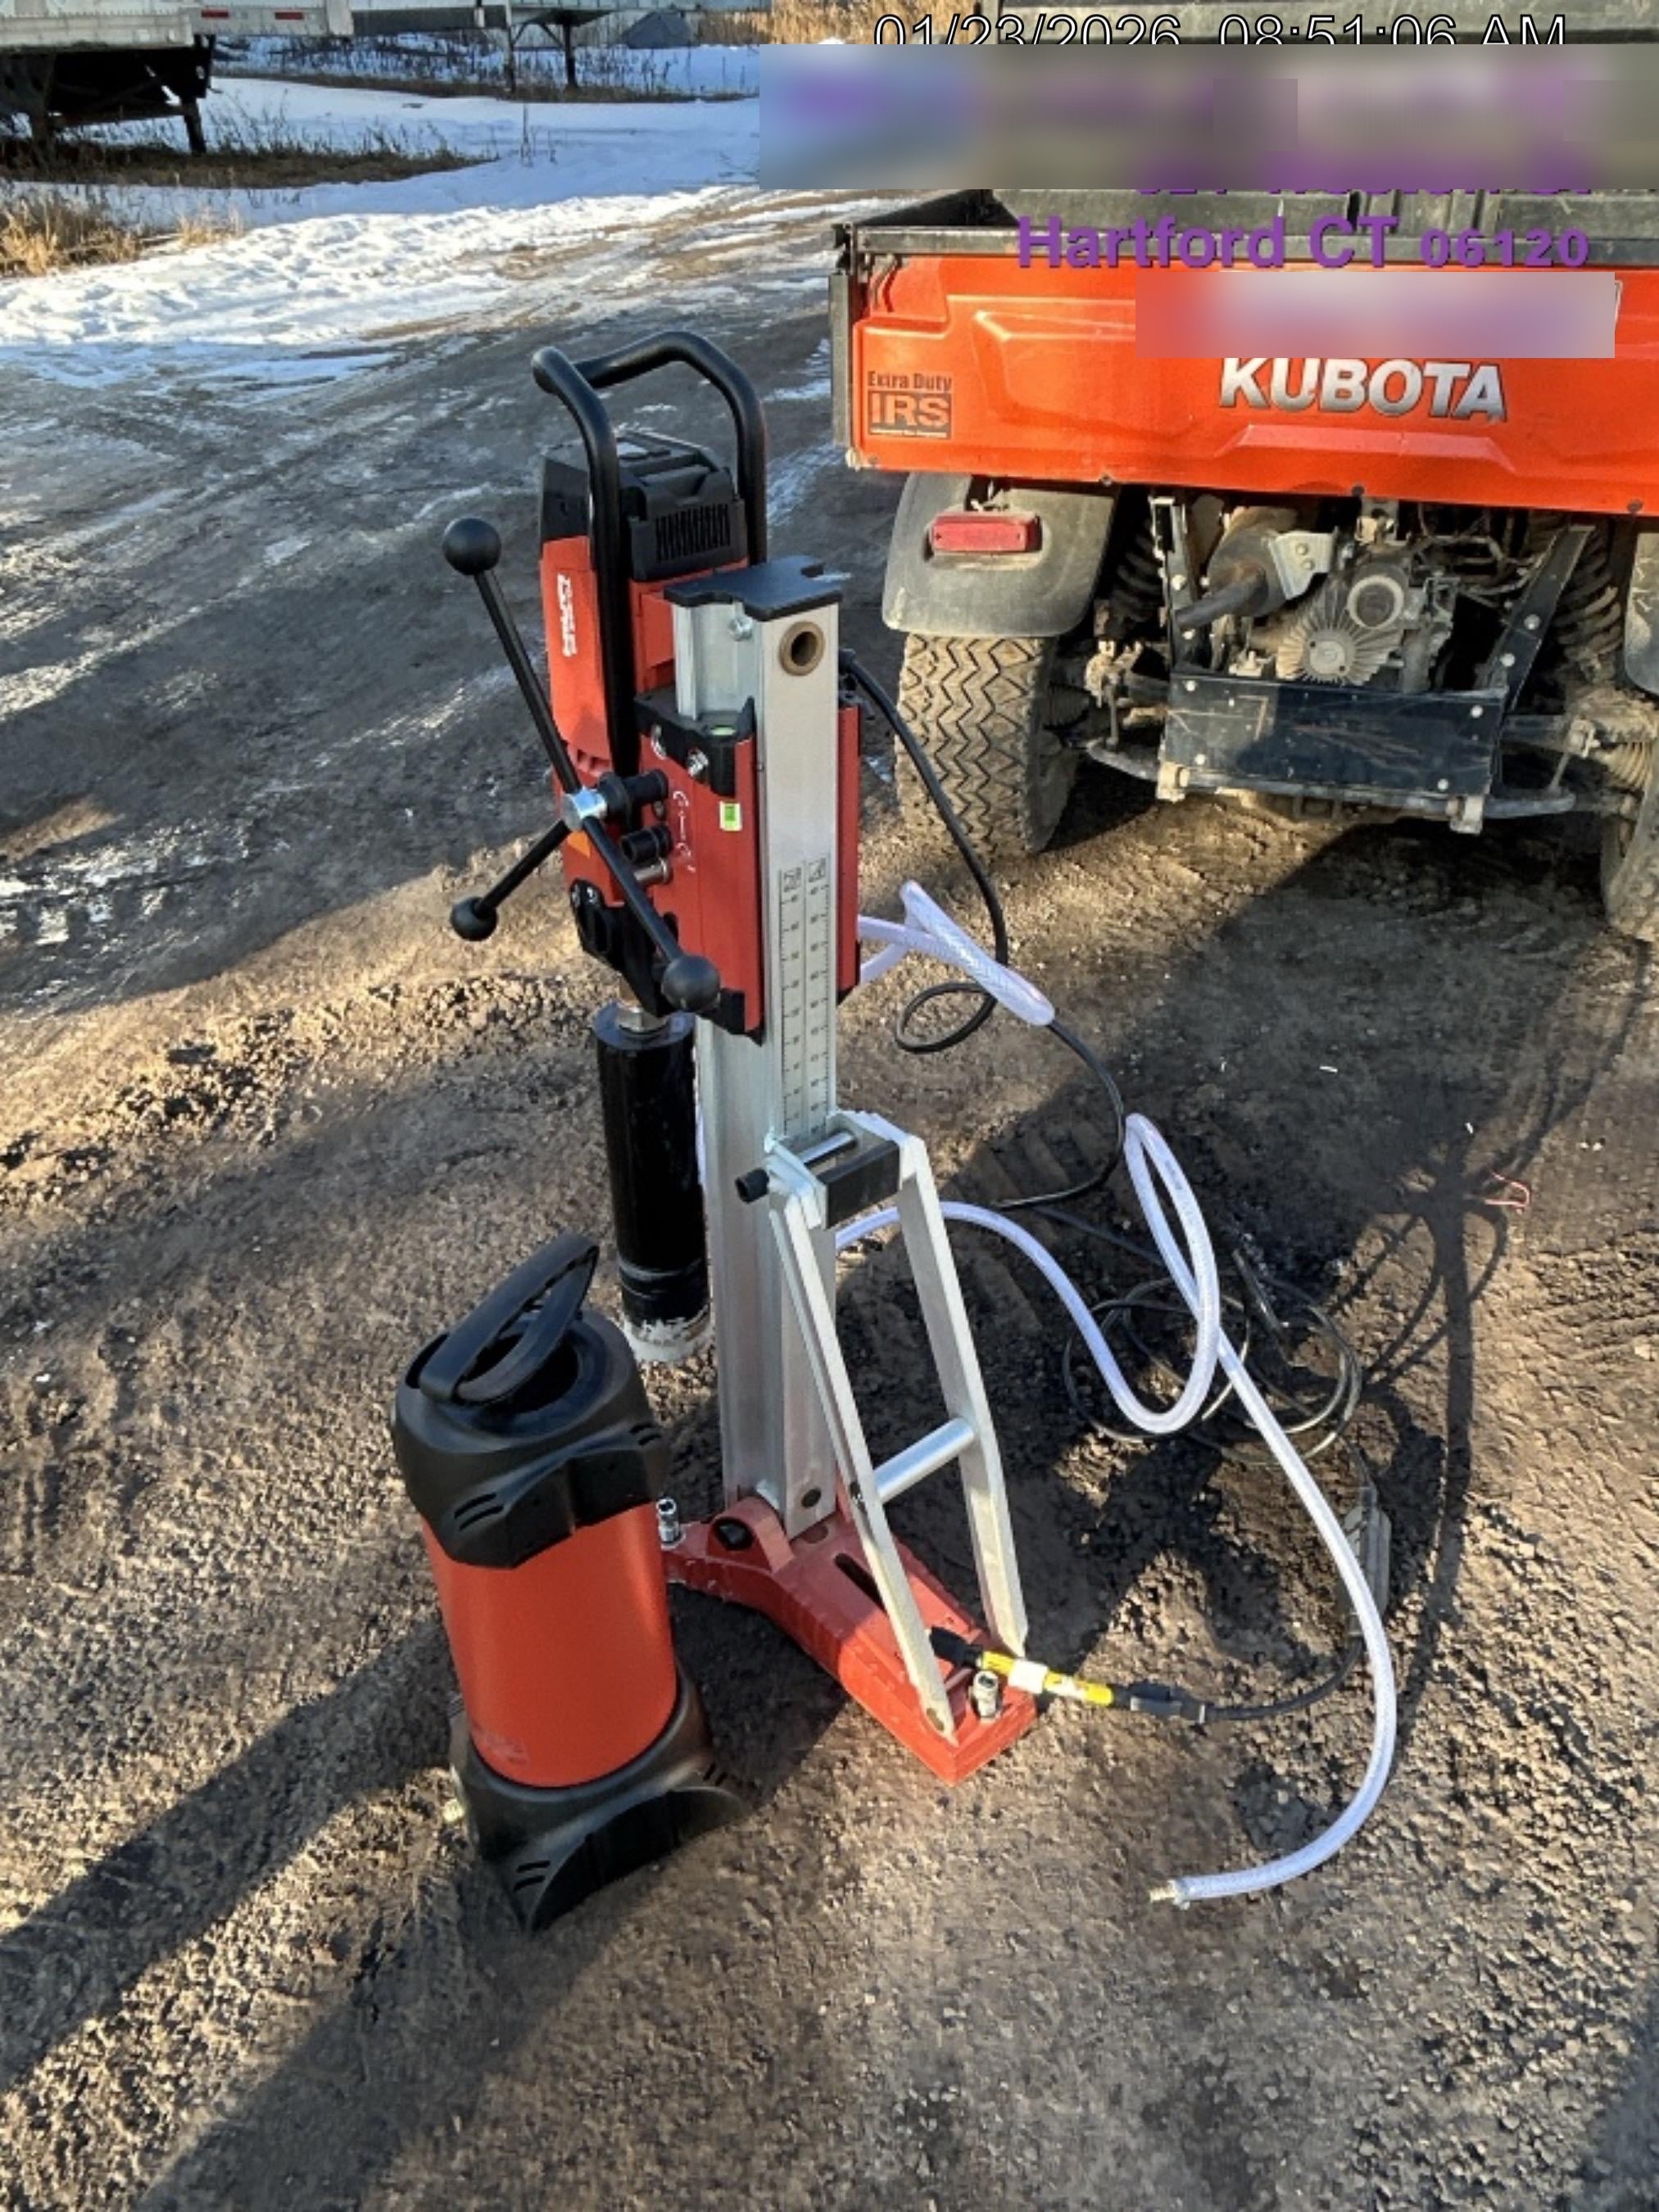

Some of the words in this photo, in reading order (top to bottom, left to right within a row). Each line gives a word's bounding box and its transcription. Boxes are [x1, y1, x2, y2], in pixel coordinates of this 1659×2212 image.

[913, 372, 952, 394] Duty
[1219, 357, 1508, 423] KUBOTA
[870, 392, 950, 428] IRS
